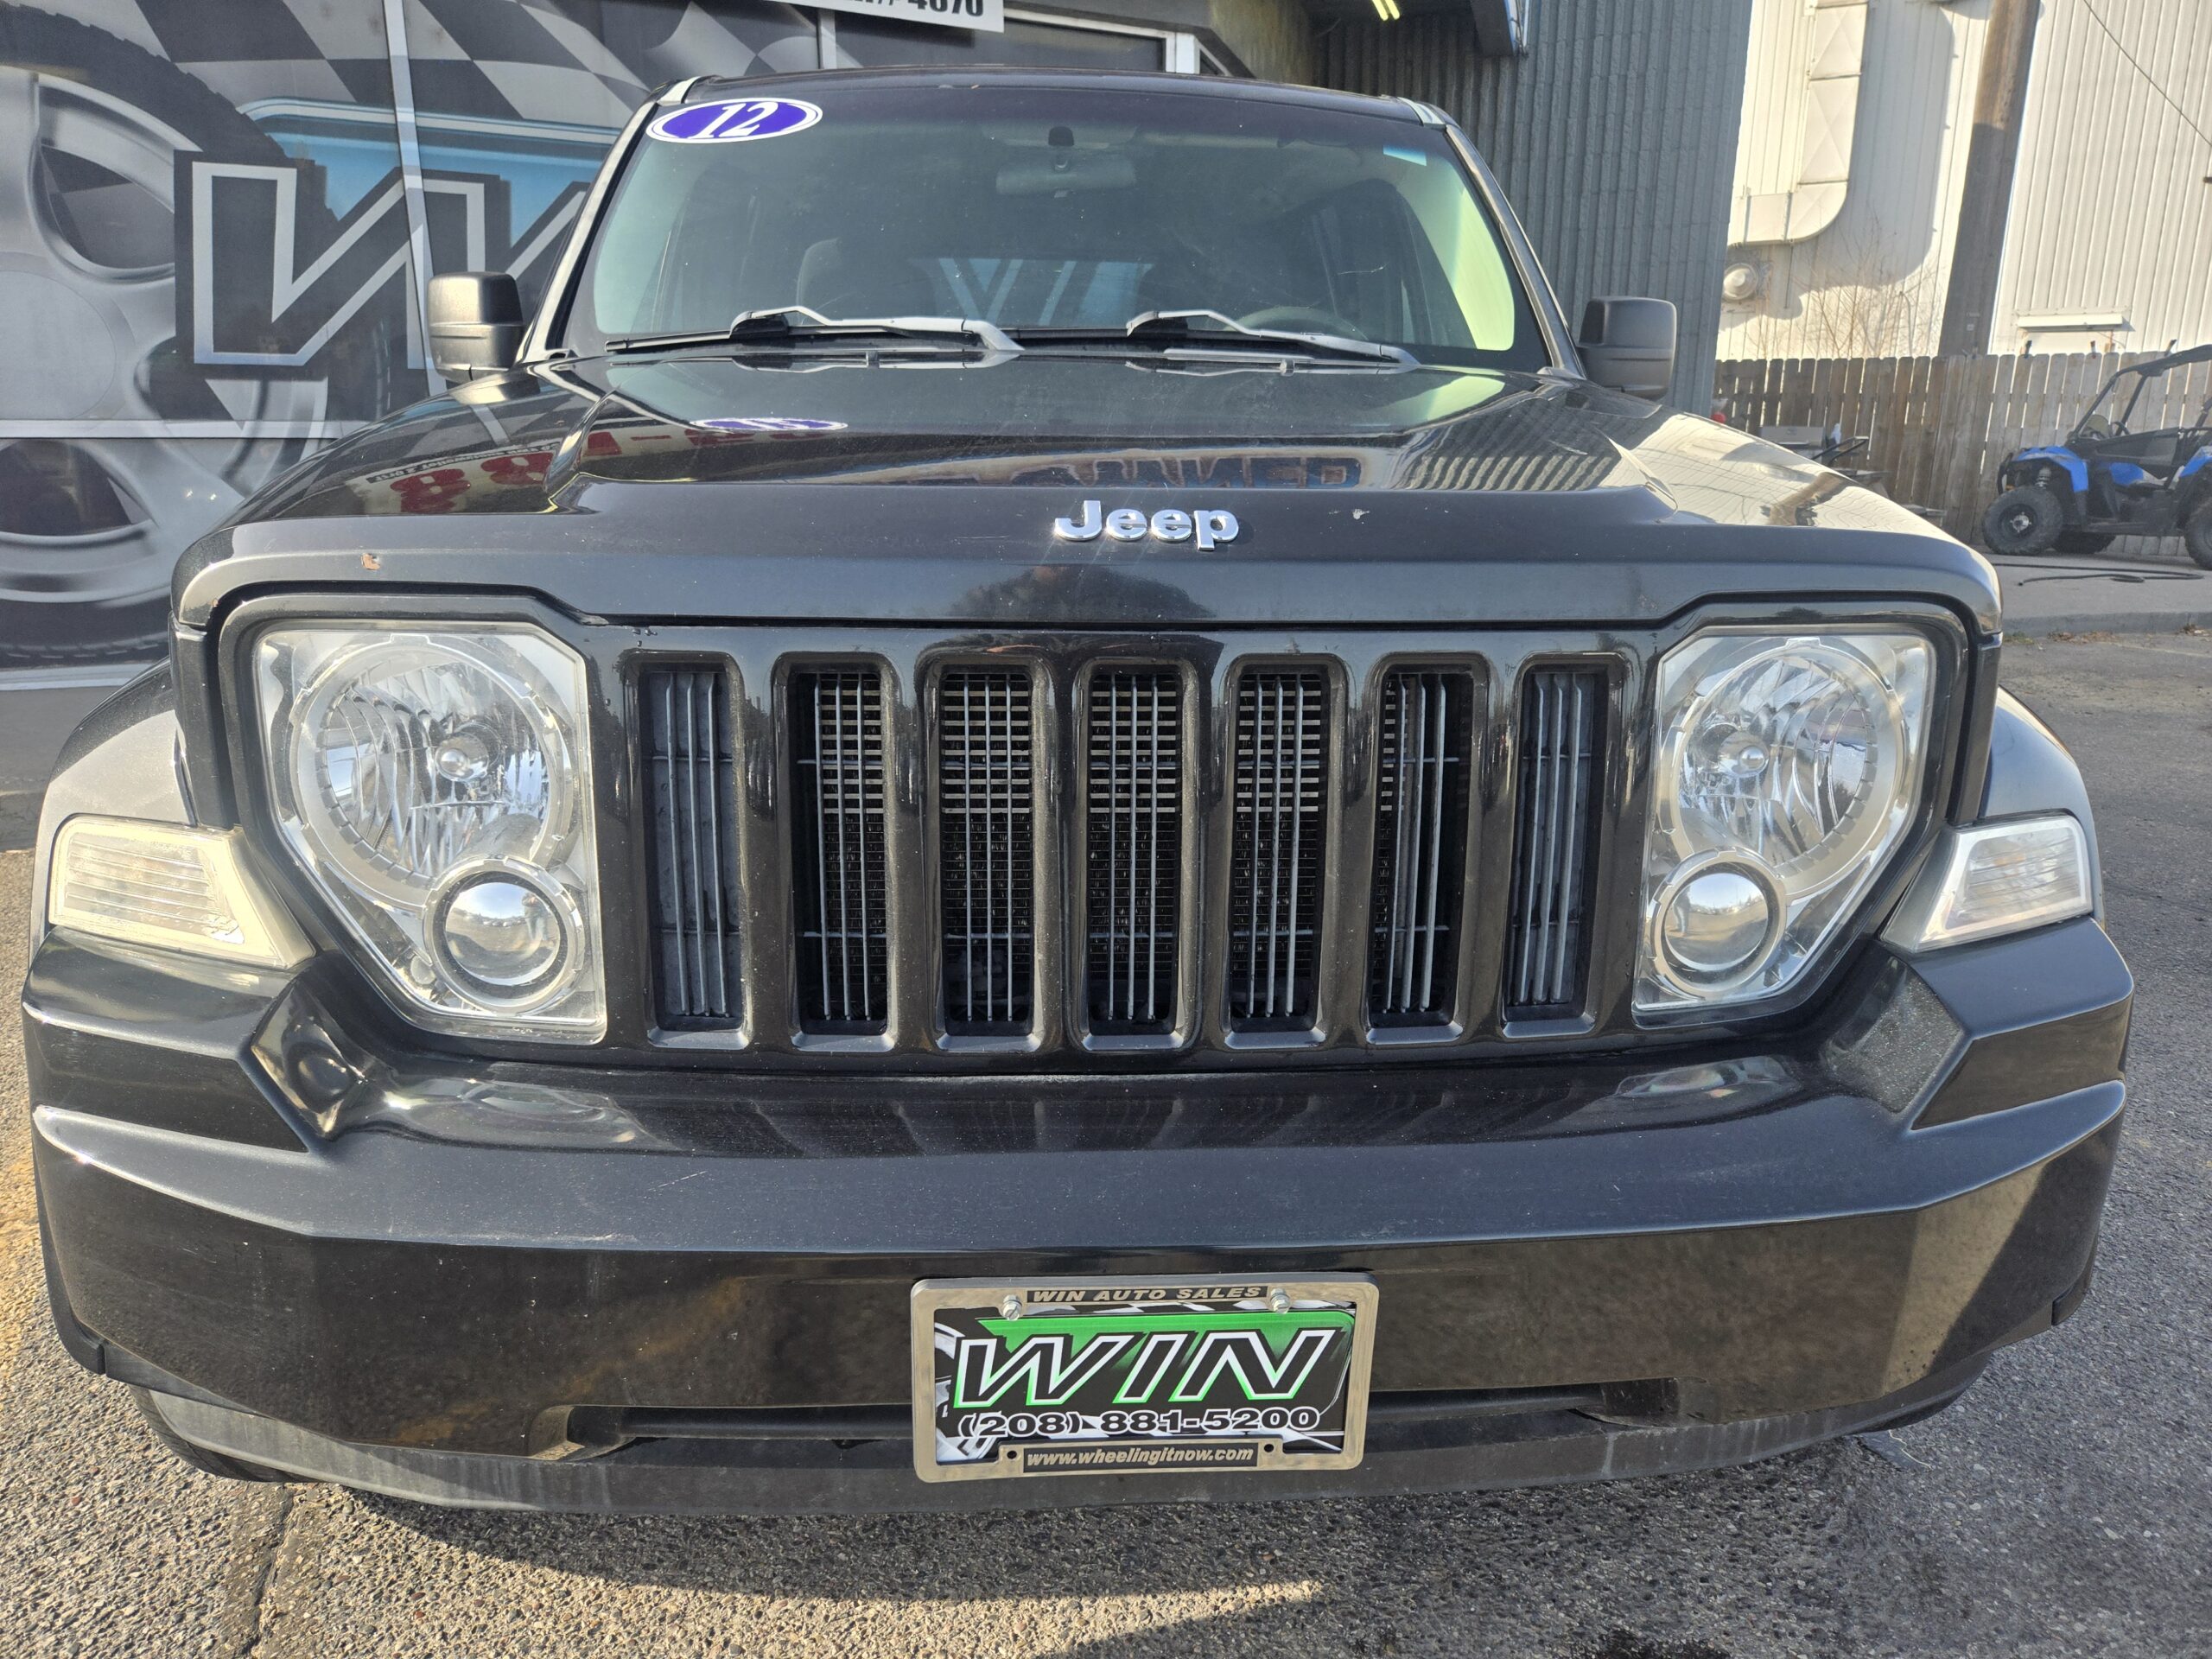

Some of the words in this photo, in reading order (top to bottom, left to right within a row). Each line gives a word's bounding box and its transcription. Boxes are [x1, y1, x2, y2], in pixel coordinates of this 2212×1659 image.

[688, 101, 779, 139] 12
[1054, 499, 1239, 550] Jeep
[1033, 1289, 1084, 1302] WIN
[1092, 1288, 1166, 1301] AUTO
[1175, 1286, 1261, 1300] SALES
[953, 1329, 1336, 1408] WIN
[958, 1413, 1083, 1436] (208)
[1100, 1408, 1320, 1433] 881-5200
[1027, 1446, 1254, 1466] www.wheelingitnow.com
